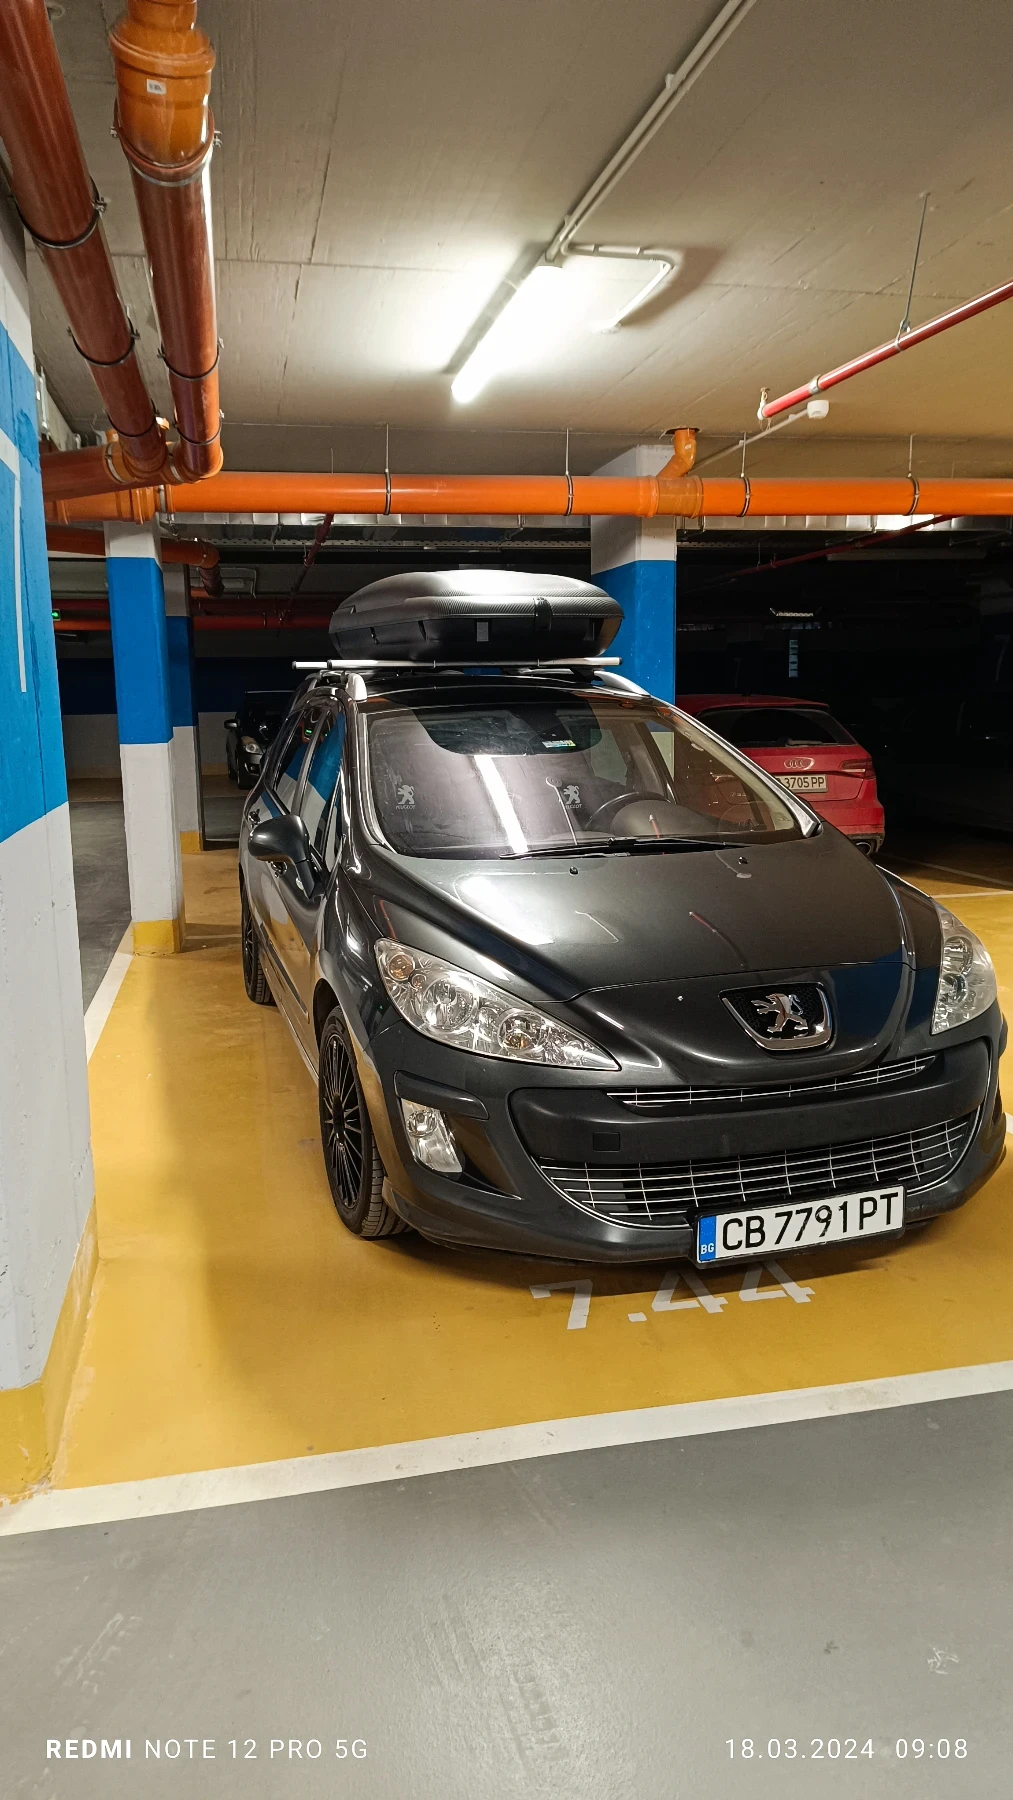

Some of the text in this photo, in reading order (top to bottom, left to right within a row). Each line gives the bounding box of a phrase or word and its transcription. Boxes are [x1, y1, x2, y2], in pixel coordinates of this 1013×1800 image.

[784, 777, 809, 788] 3705
[810, 777, 824, 788] PP
[721, 1191, 899, 1251] CB 7791 PT
[700, 1242, 715, 1255] BG
